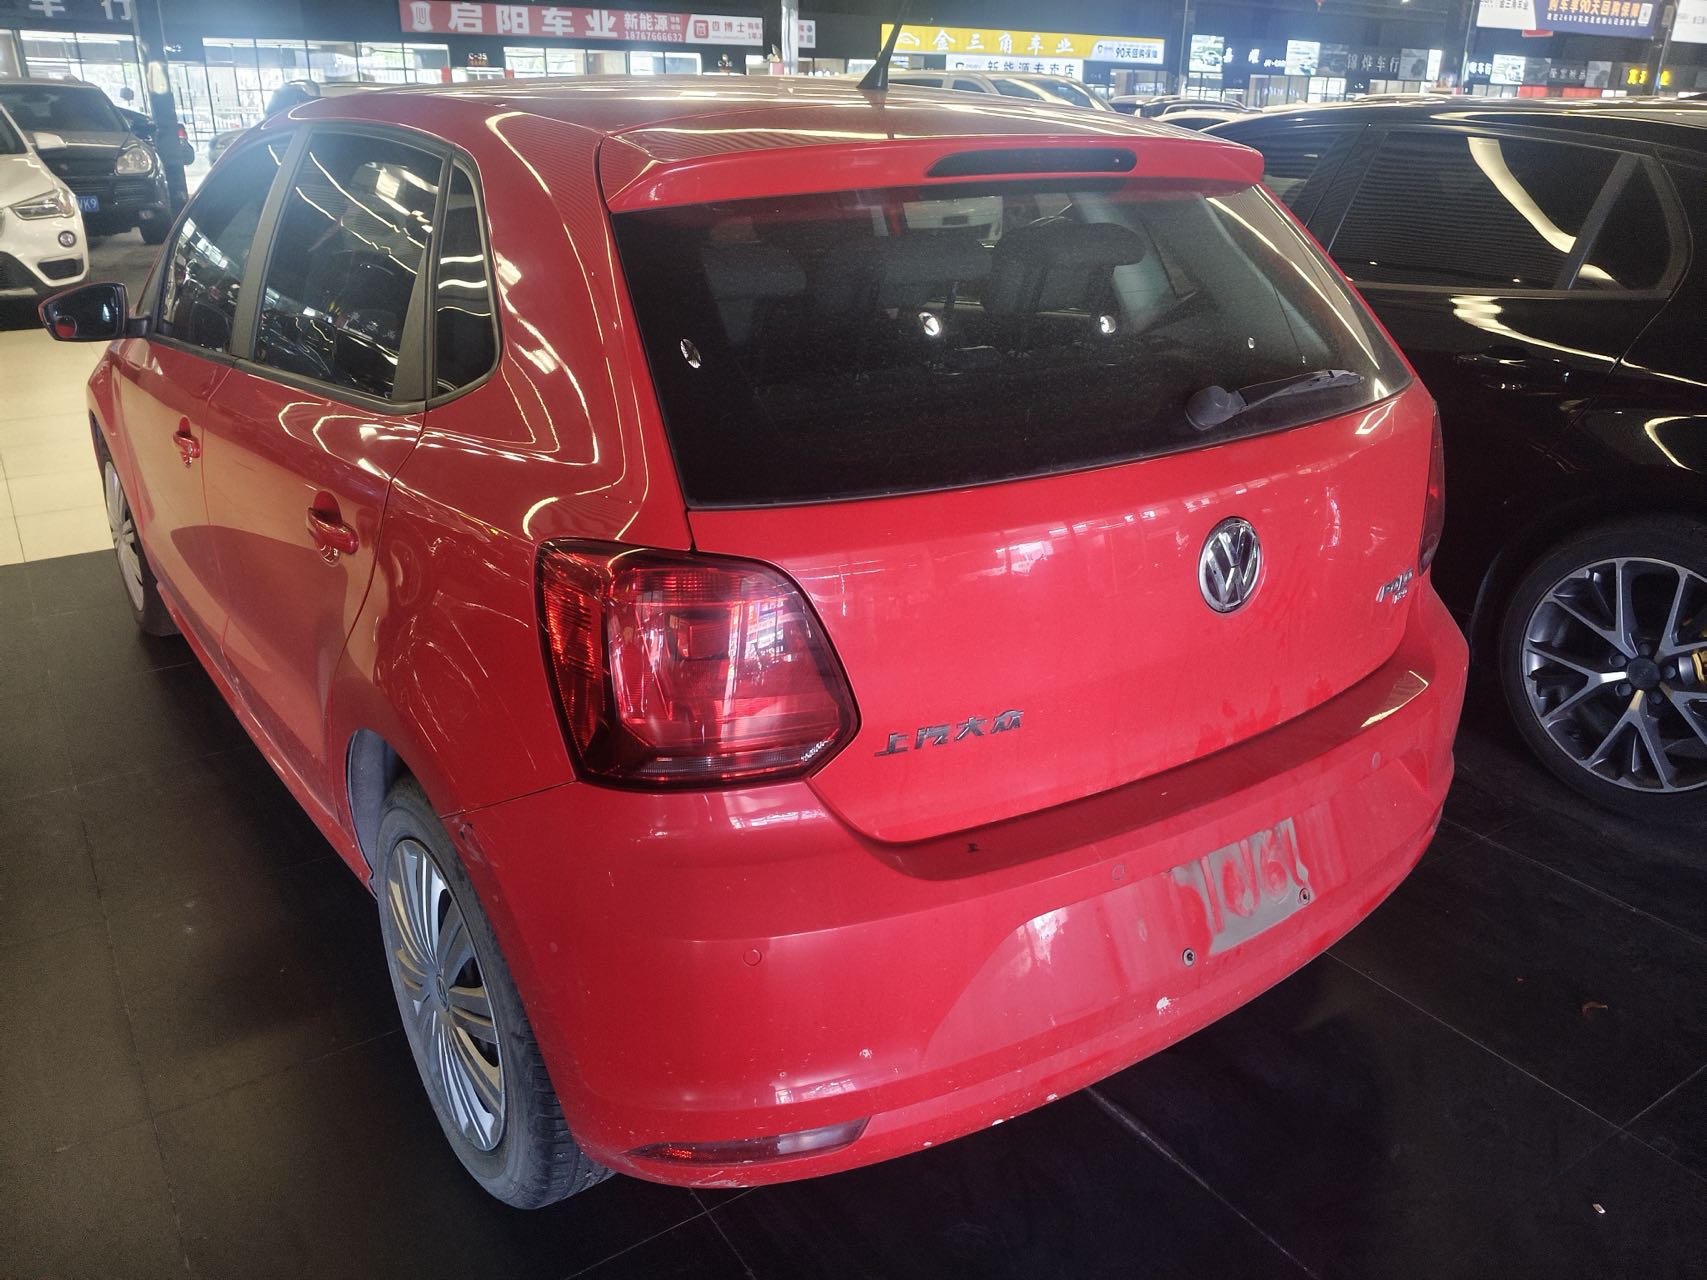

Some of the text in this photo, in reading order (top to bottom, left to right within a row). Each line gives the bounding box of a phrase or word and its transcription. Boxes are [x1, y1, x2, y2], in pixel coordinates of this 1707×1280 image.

[448, 2, 618, 38] 启阳车业
[623, 12, 668, 31] 新能源
[874, 709, 1024, 757] 上汽大众
